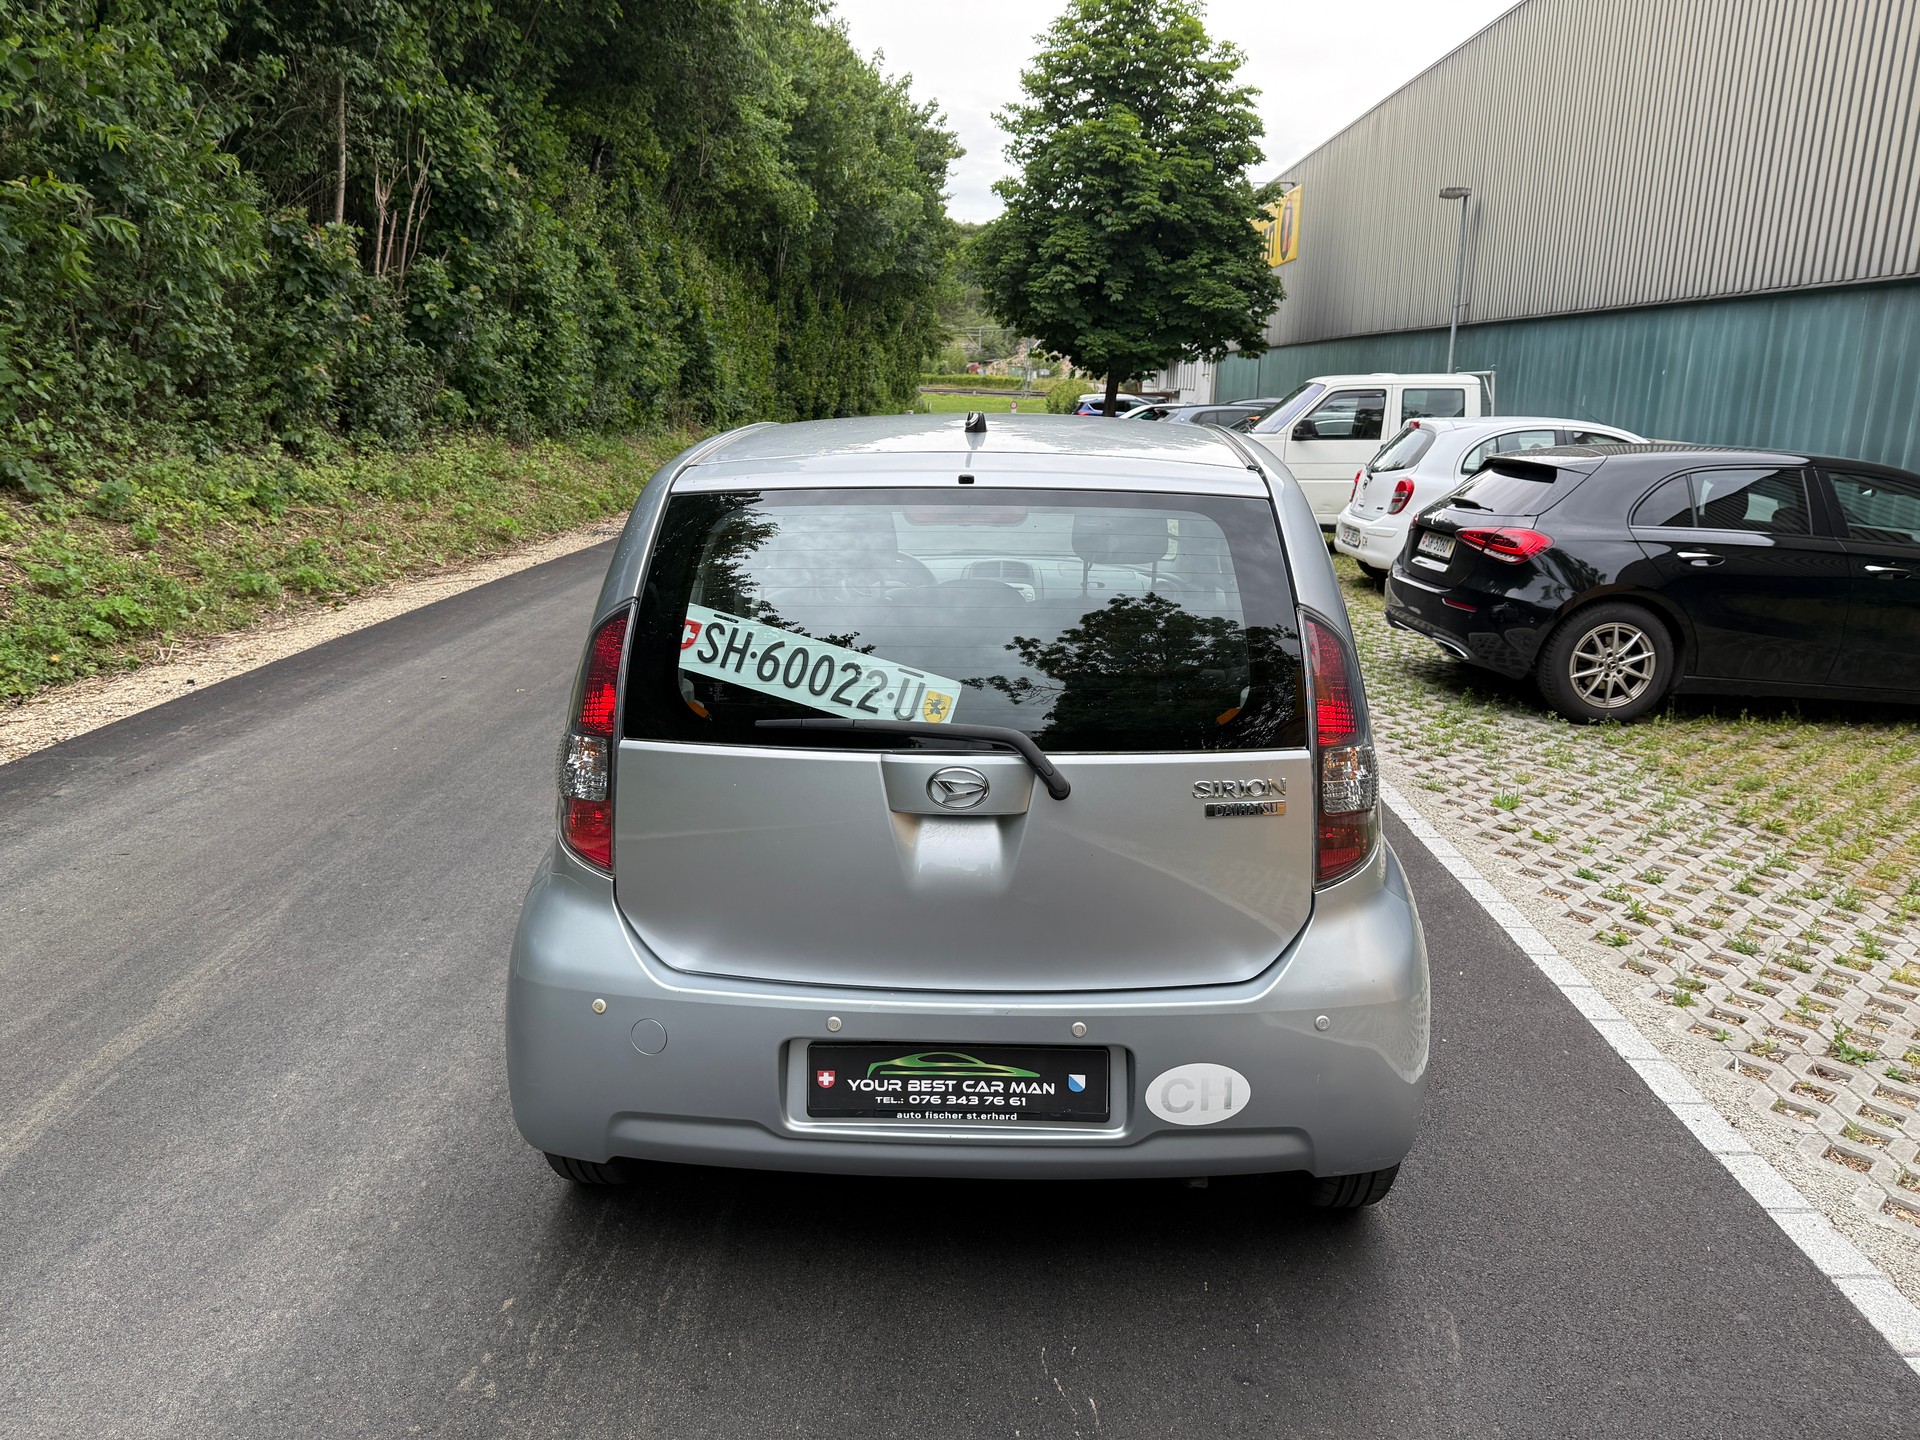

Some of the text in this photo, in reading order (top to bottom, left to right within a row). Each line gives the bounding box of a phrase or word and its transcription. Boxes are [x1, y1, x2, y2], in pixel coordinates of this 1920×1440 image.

[1192, 778, 1286, 799] SIRION
[1214, 802, 1279, 817] DAIHATSU
[847, 1079, 1055, 1095] YOUR BEST CAR MAN
[875, 1095, 1026, 1106] TEL.: 076 343 76 61
[1161, 1077, 1232, 1113] CH
[896, 1110, 1017, 1120] auto fischer st.erhard
